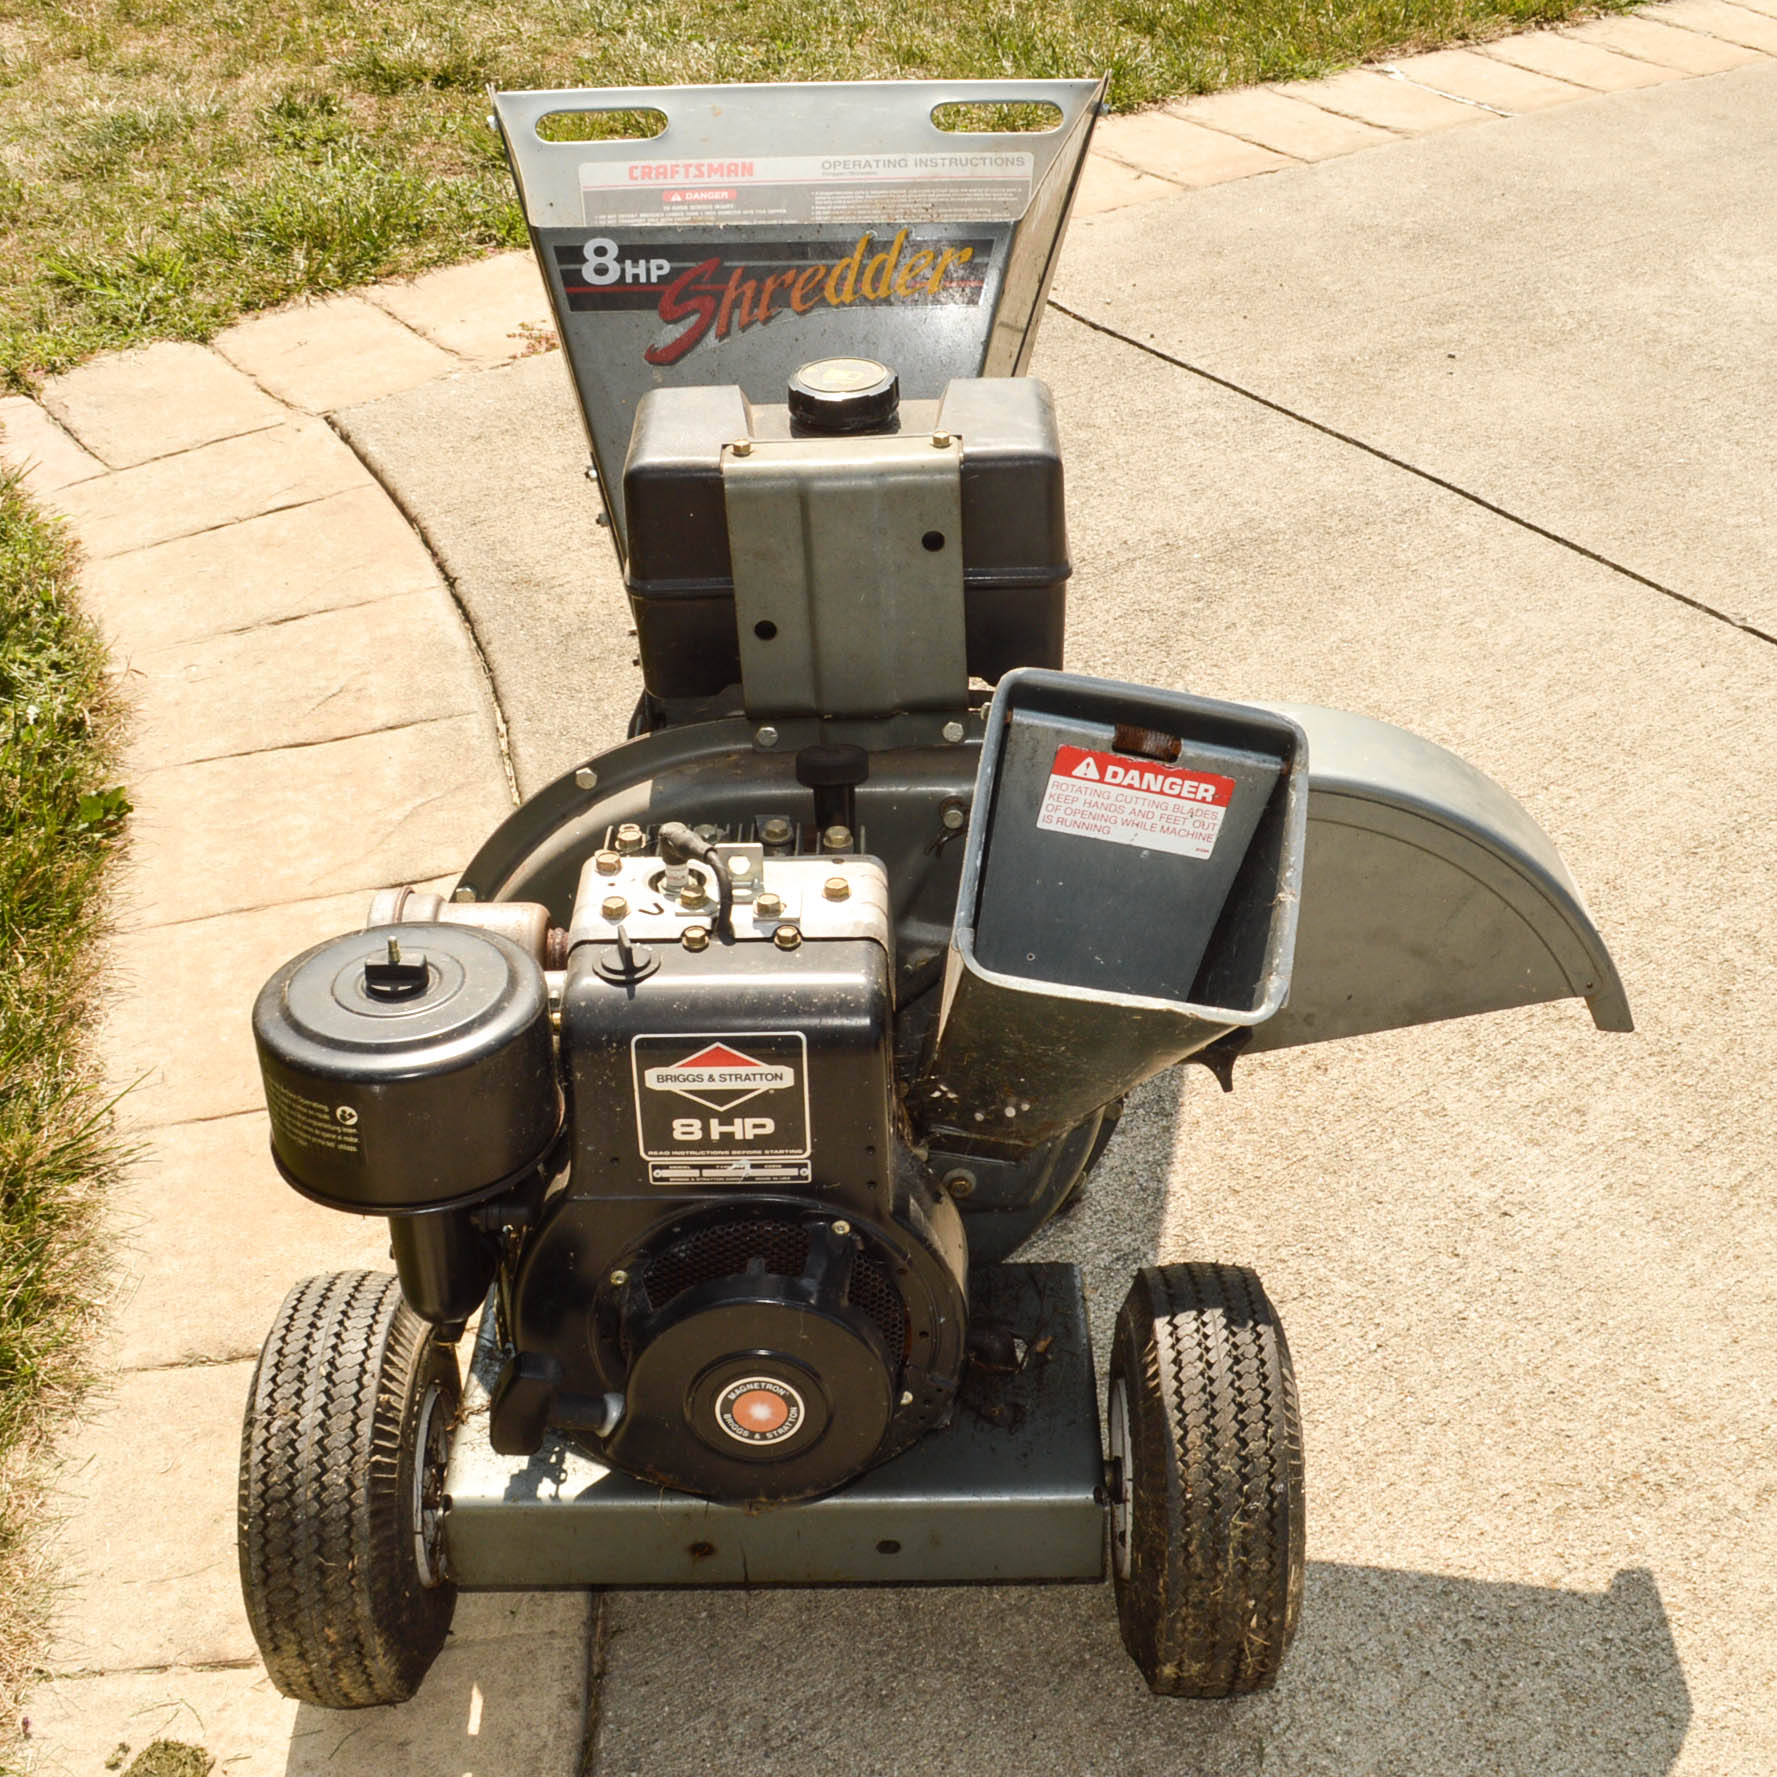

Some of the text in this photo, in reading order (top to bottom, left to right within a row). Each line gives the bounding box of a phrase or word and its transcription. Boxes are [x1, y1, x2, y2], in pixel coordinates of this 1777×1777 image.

[628, 162, 754, 181] CRAFTSMAN
[821, 156, 1025, 170] OPERATING INSTRUCTIONS
[685, 191, 728, 200] DANGER
[644, 227, 974, 366] Shredder
[1051, 780, 1111, 800] ROTATING
[1115, 793, 1169, 811] CUTTING
[1104, 765, 1216, 802] DANGER
[1042, 814, 1053, 824] IS
[1045, 803, 1215, 843] OF OPENING WHILE MACHINE
[1048, 792, 1217, 832] KEEP HANDS AND FEET OUT
[656, 1072, 783, 1083] BRIGGS & STRATTON
[672, 1117, 775, 1141] 8 HP
[723, 1413, 750, 1437] BRIGGS
[766, 1406, 798, 1439] STRATTON
